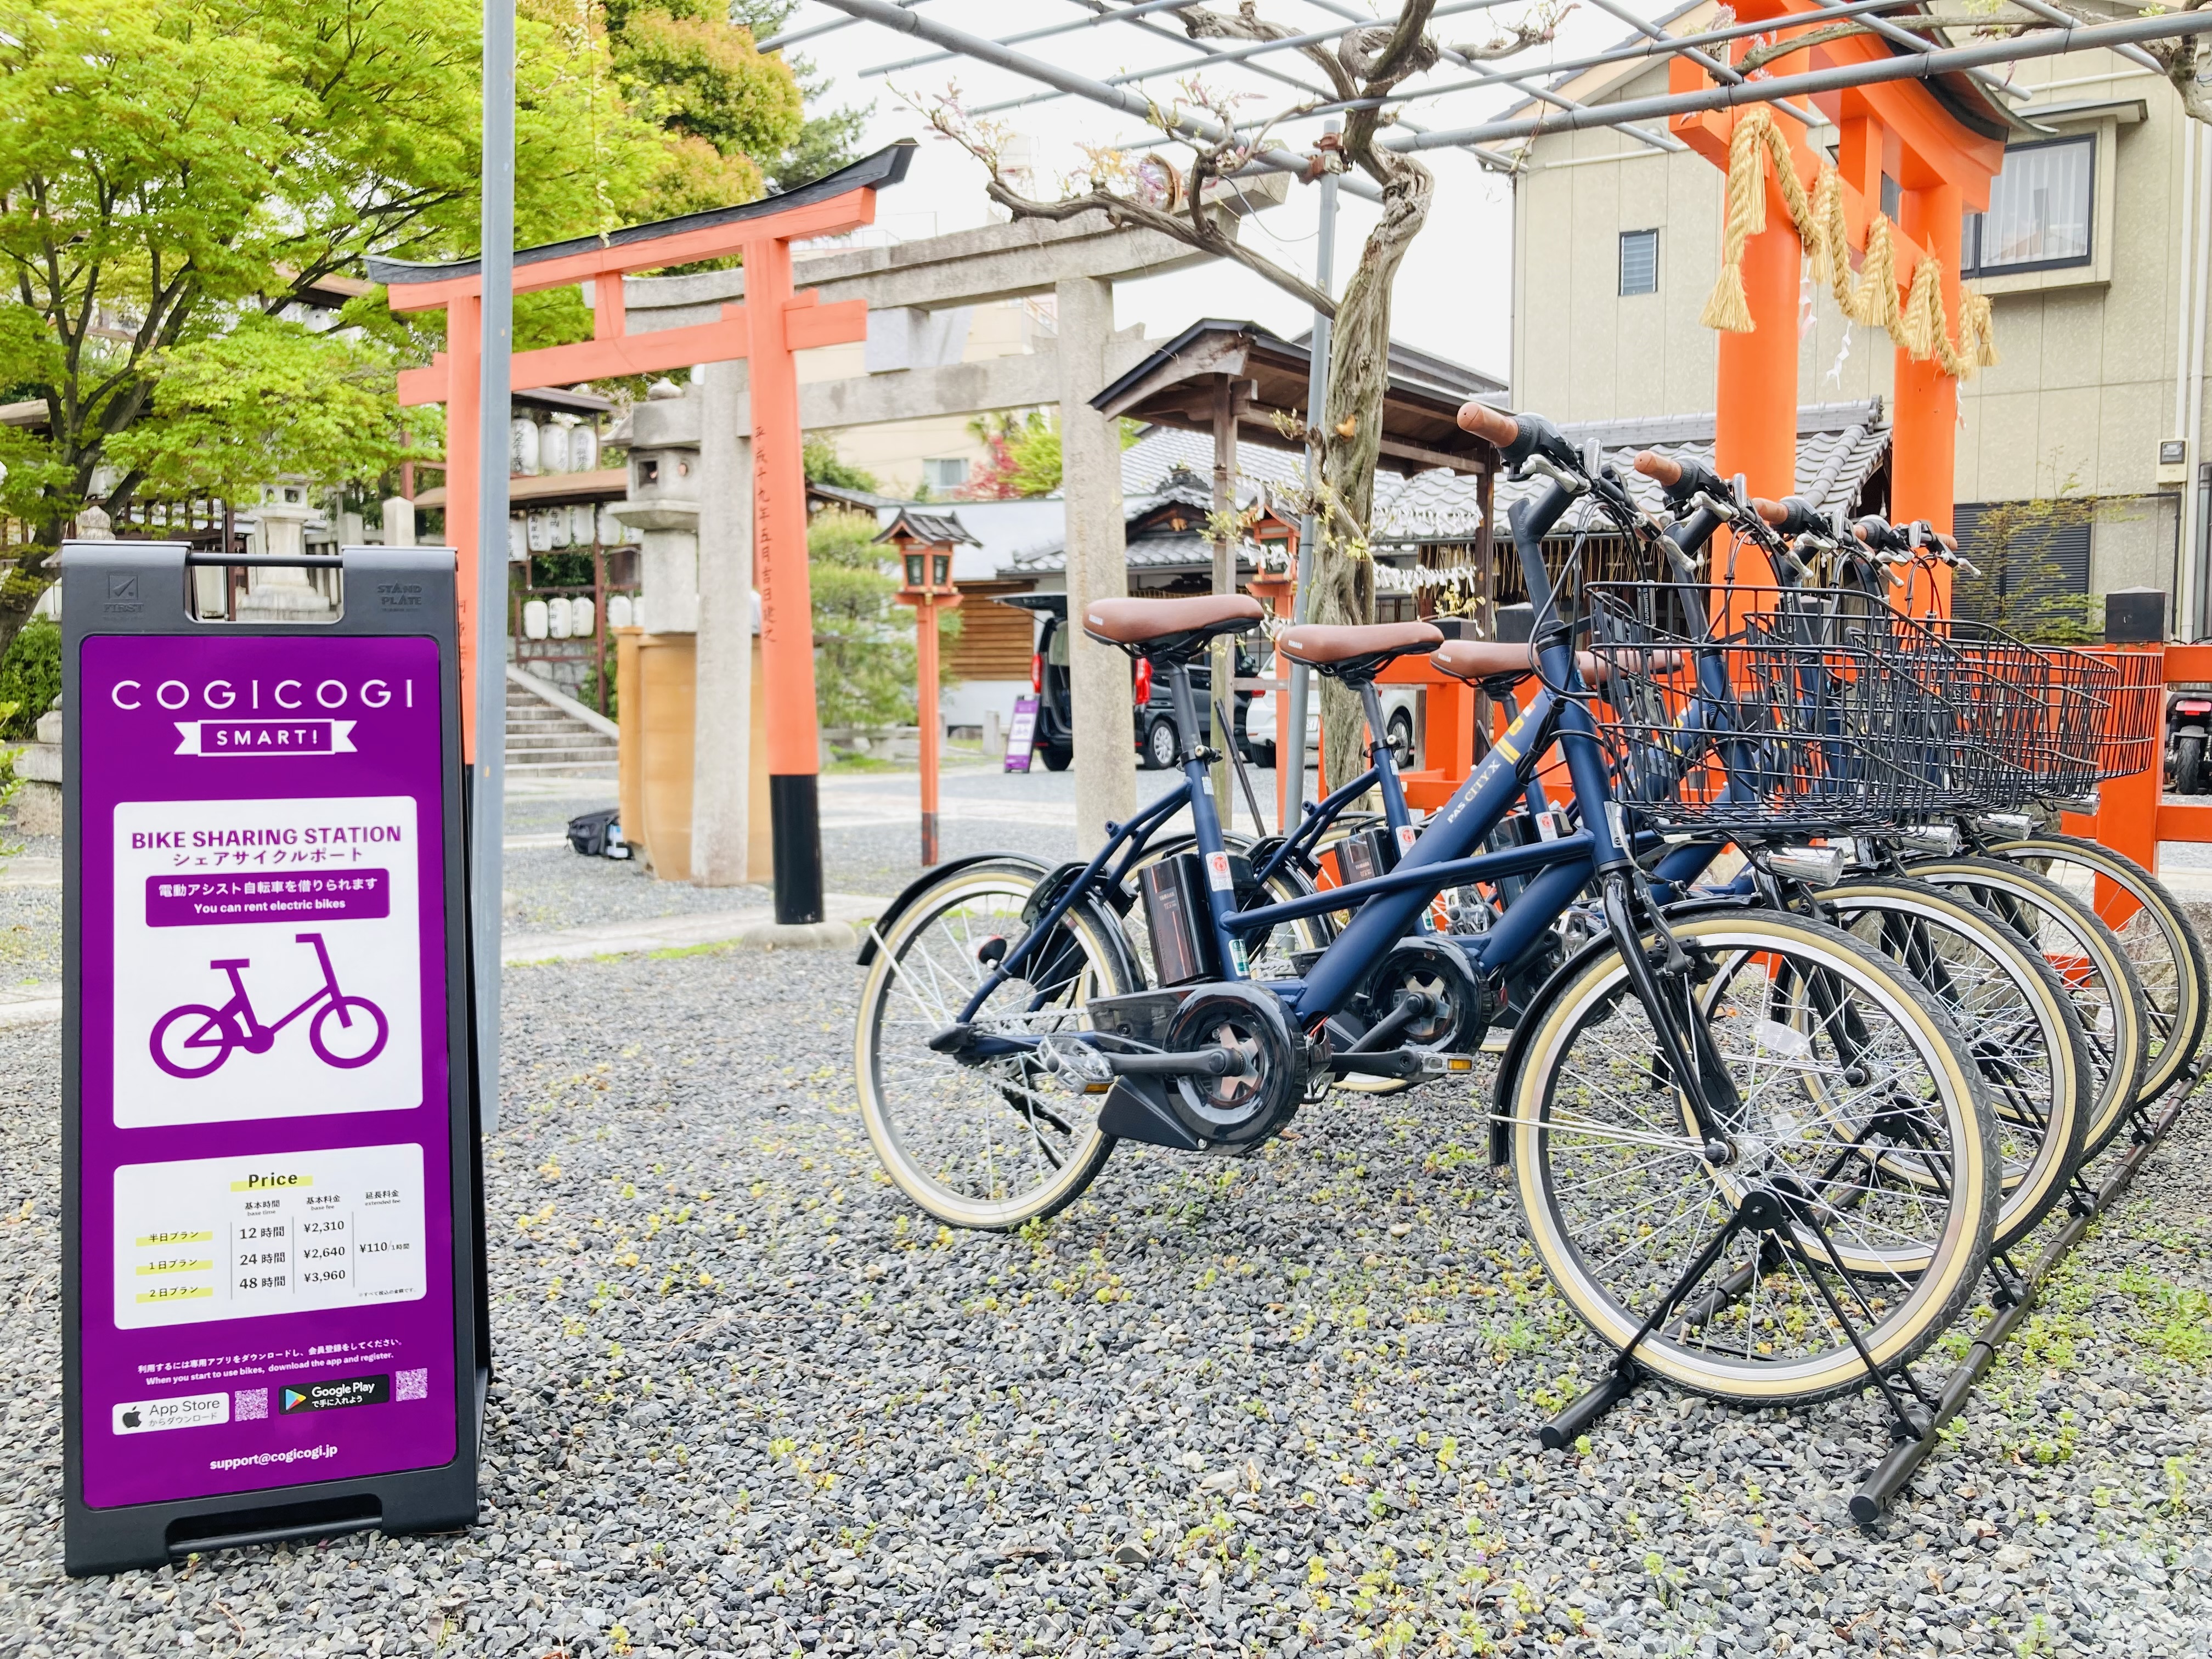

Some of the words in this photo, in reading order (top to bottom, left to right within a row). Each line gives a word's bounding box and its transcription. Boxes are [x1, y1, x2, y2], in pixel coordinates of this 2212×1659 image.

[377, 582, 422, 593] STAND
[381, 594, 422, 605] PLATE
[103, 603, 144, 613] FIRST
[111, 679, 414, 710] COGICOGI
[216, 729, 318, 746] SMART!
[1447, 802, 1466, 824] PAS
[1464, 772, 1490, 803] CITY
[132, 831, 186, 849] BIKE
[193, 827, 298, 848] SHARING
[304, 825, 402, 845] STATION
[173, 848, 363, 866] シェアサイクルポート
[159, 877, 379, 897] 電動アシスト自転車を借りられます
[194, 902, 217, 914] You
[220, 903, 242, 912] can
[245, 900, 268, 911] rent
[270, 899, 313, 911] electric
[315, 898, 346, 910] bikes
[249, 1172, 298, 1188] Price
[306, 1195, 341, 1205] 基本料金
[365, 1189, 399, 1199] 延長料金
[245, 1200, 280, 1210] 基本時間
[240, 1228, 257, 1239] 12
[261, 1226, 285, 1238] 時間
[304, 1221, 345, 1234] ¥2,310
[149, 1231, 199, 1243] 半日プラン
[240, 1254, 257, 1266] 24
[261, 1252, 285, 1264] 時間
[304, 1246, 345, 1260] ¥2,640
[239, 1277, 257, 1289] 48
[262, 1276, 285, 1288] 時間
[304, 1270, 346, 1284] ¥3,960
[146, 1375, 171, 1385] When
[173, 1375, 189, 1384] you
[190, 1372, 211, 1381] start
[239, 1367, 265, 1376] bikes,
[268, 1360, 309, 1372] download
[311, 1358, 325, 1367] the
[326, 1358, 342, 1367] app
[343, 1355, 359, 1364] and
[360, 1352, 394, 1363] register.
[311, 1383, 351, 1398] Google
[353, 1382, 375, 1393] Play
[149, 1404, 178, 1417] App
[182, 1400, 220, 1412] Store
[312, 1395, 363, 1408] で手に入れよう
[149, 1412, 218, 1427] からダウンロード
[210, 1444, 338, 1471] support@cogicogi.jp
